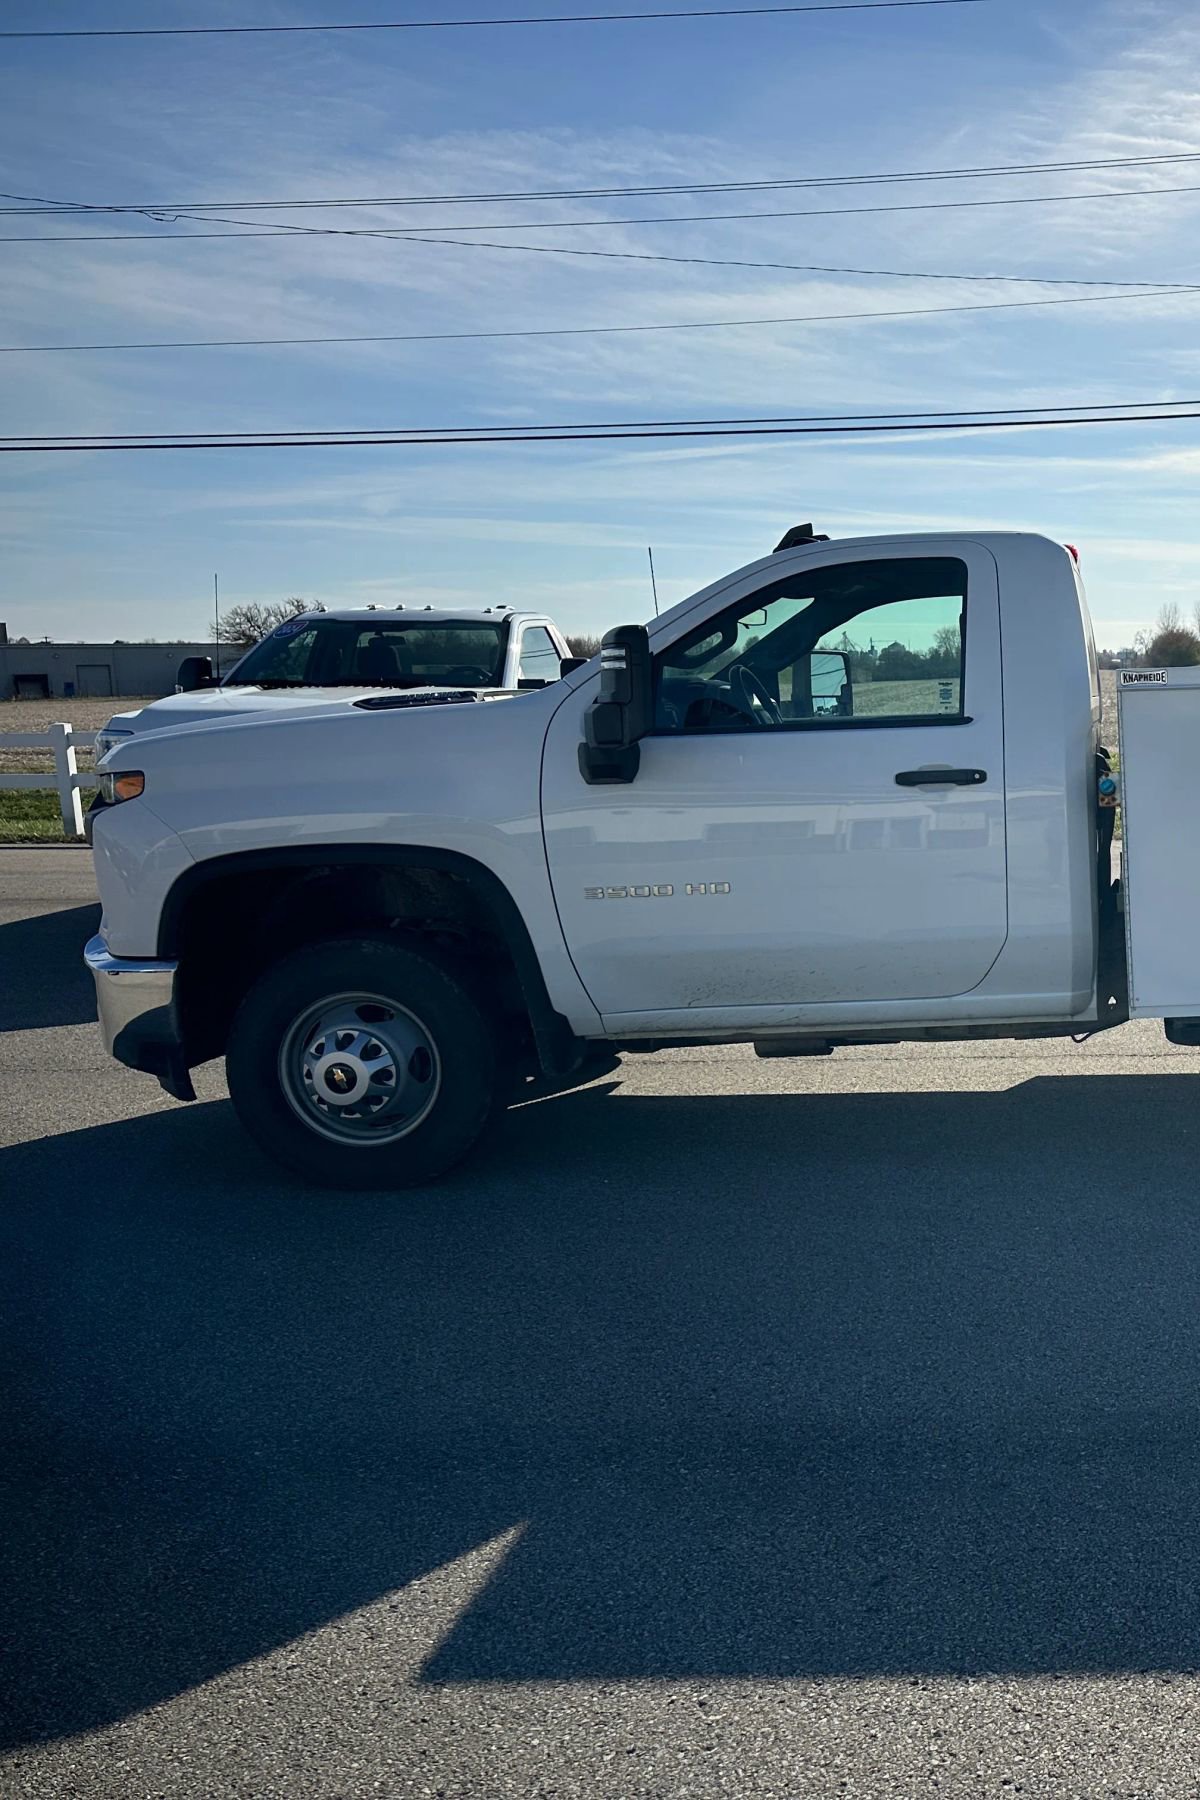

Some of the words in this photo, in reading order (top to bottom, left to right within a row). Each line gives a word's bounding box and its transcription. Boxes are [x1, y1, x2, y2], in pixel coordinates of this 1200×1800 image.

[1122, 671, 1166, 684] KNAPHEIDE
[584, 884, 674, 900] 3500
[685, 881, 731, 896] HD
